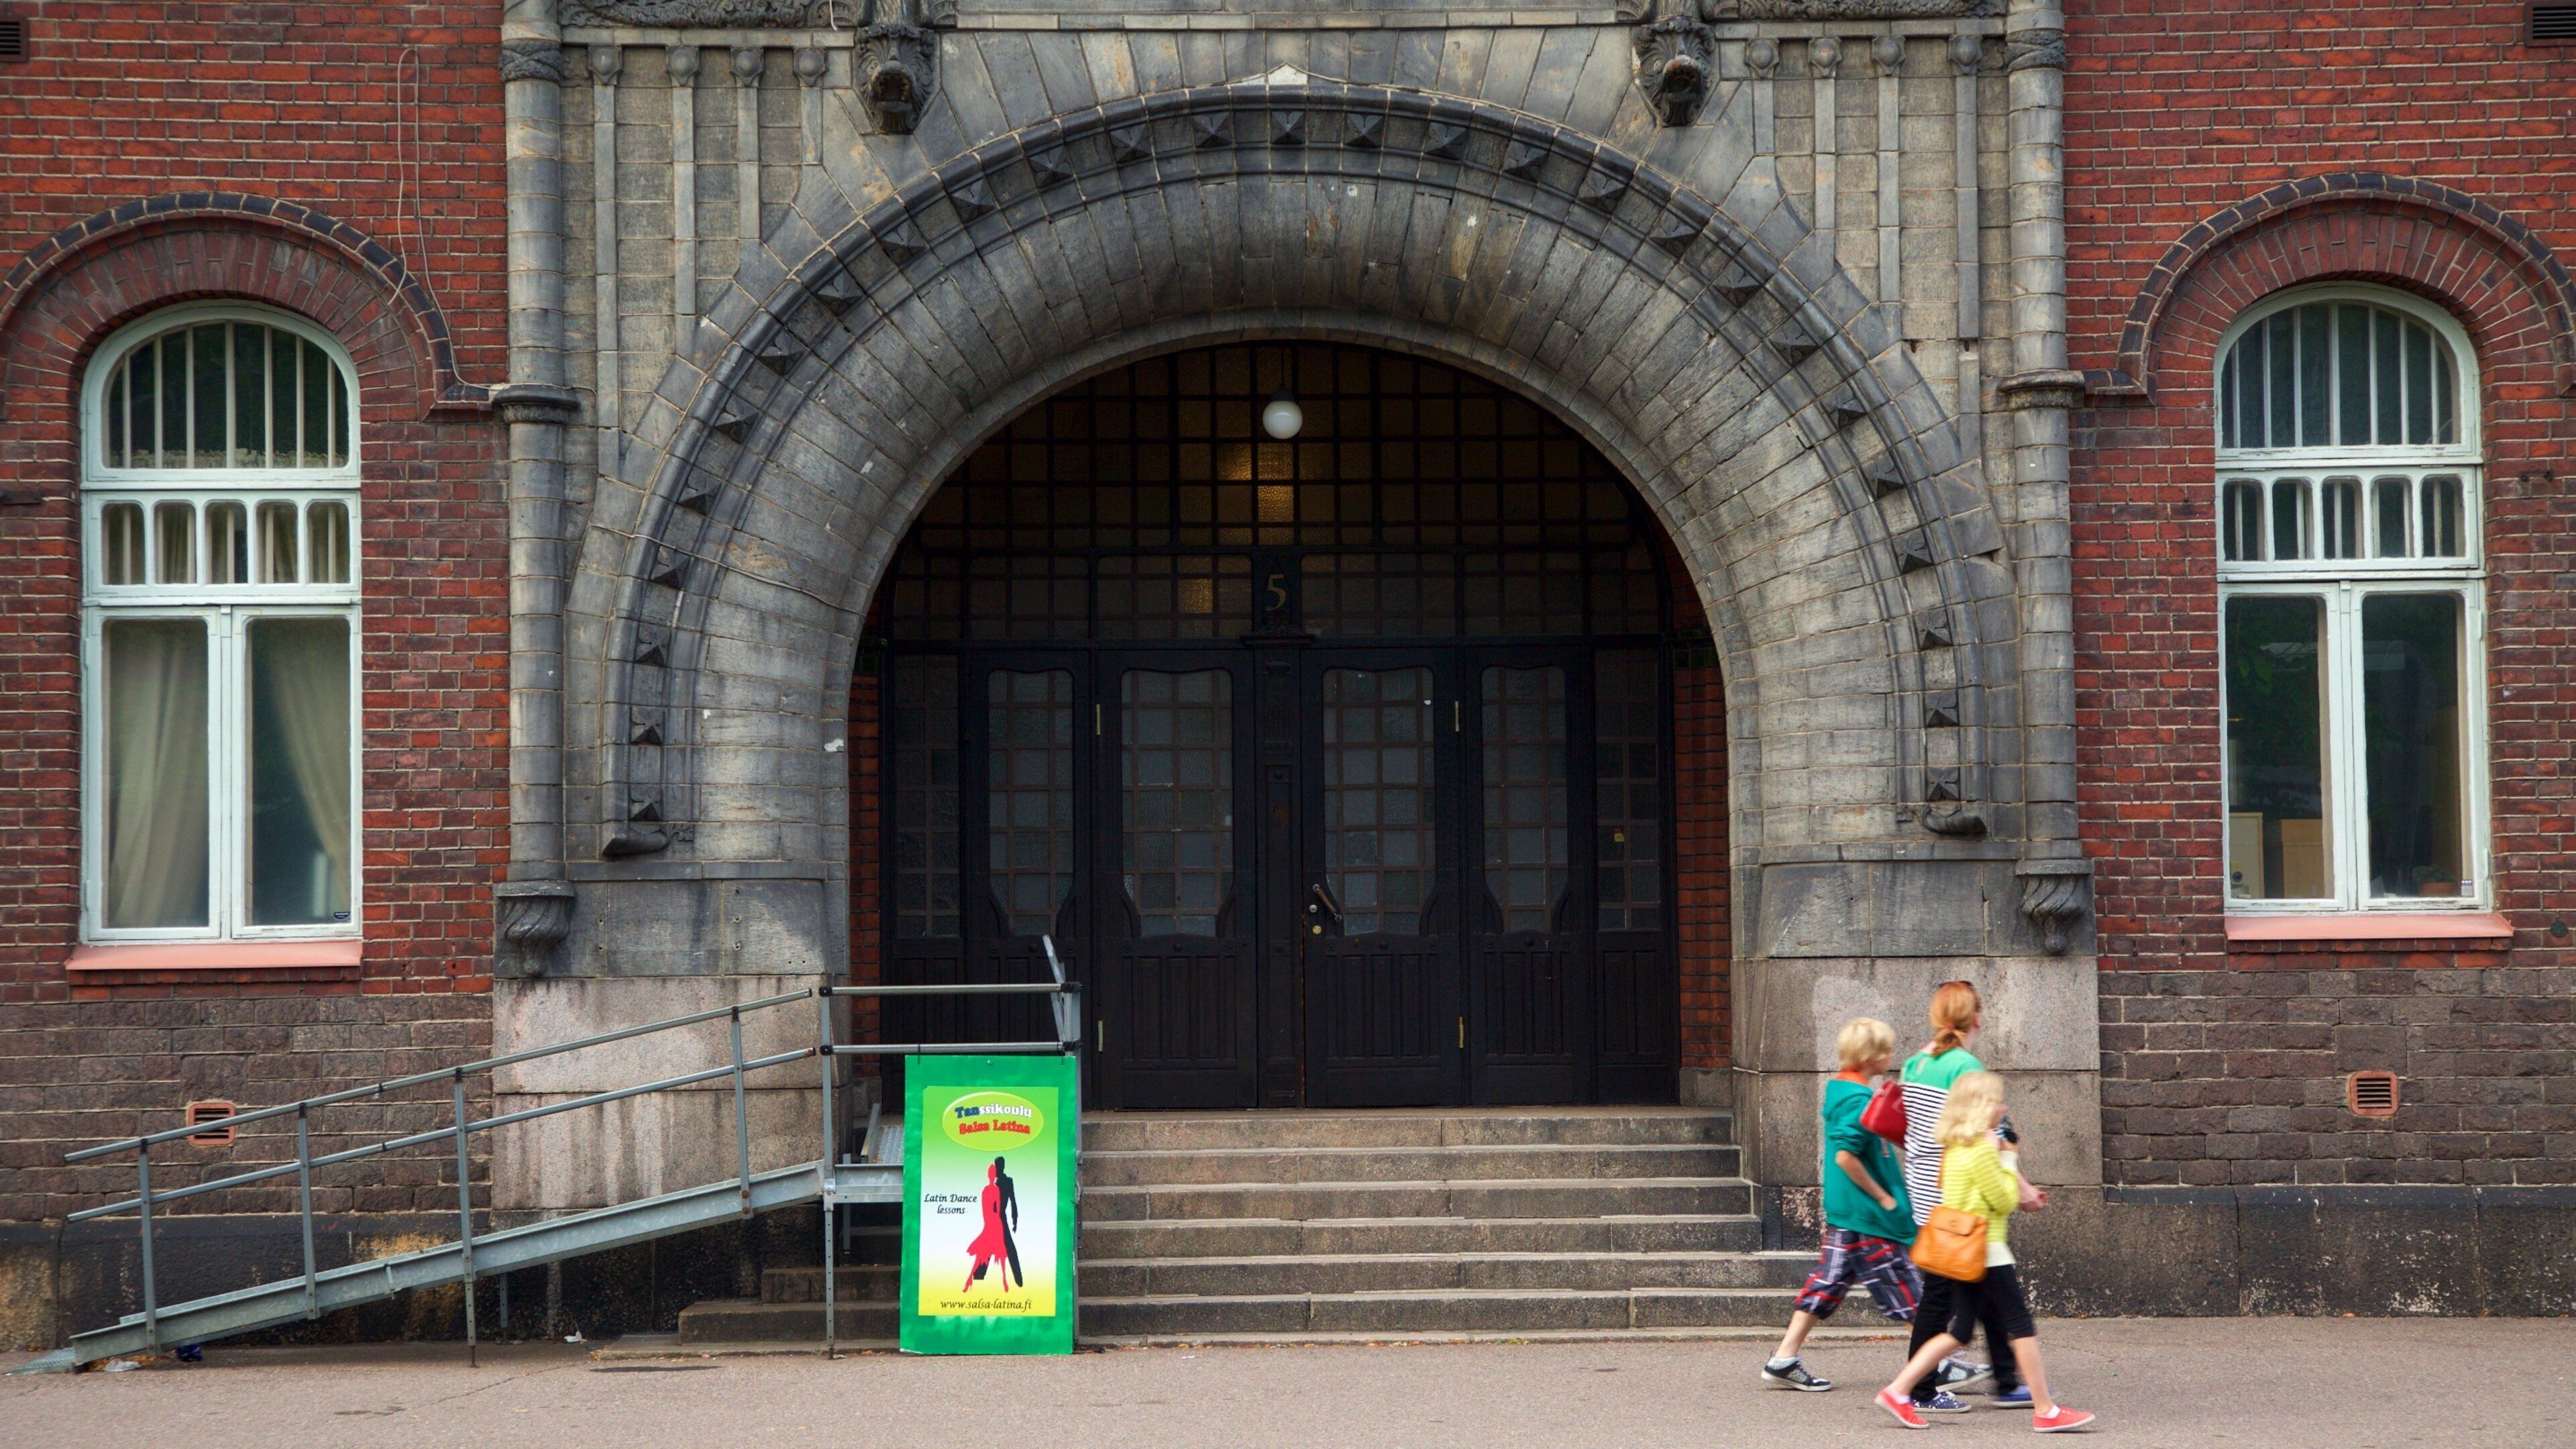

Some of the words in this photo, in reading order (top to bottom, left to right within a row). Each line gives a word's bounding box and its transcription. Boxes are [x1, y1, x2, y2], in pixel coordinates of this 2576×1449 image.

[1265, 574, 1286, 612] 5
[955, 1104, 1032, 1118] Tanssikoulu
[959, 1121, 989, 1134] Salsa
[993, 1119, 1030, 1134] Latina
[924, 1193, 947, 1203] Latin
[950, 1193, 977, 1203] Dance
[937, 1204, 965, 1214] lessons
[940, 1298, 1032, 1313] www.salsa-latina.fi
